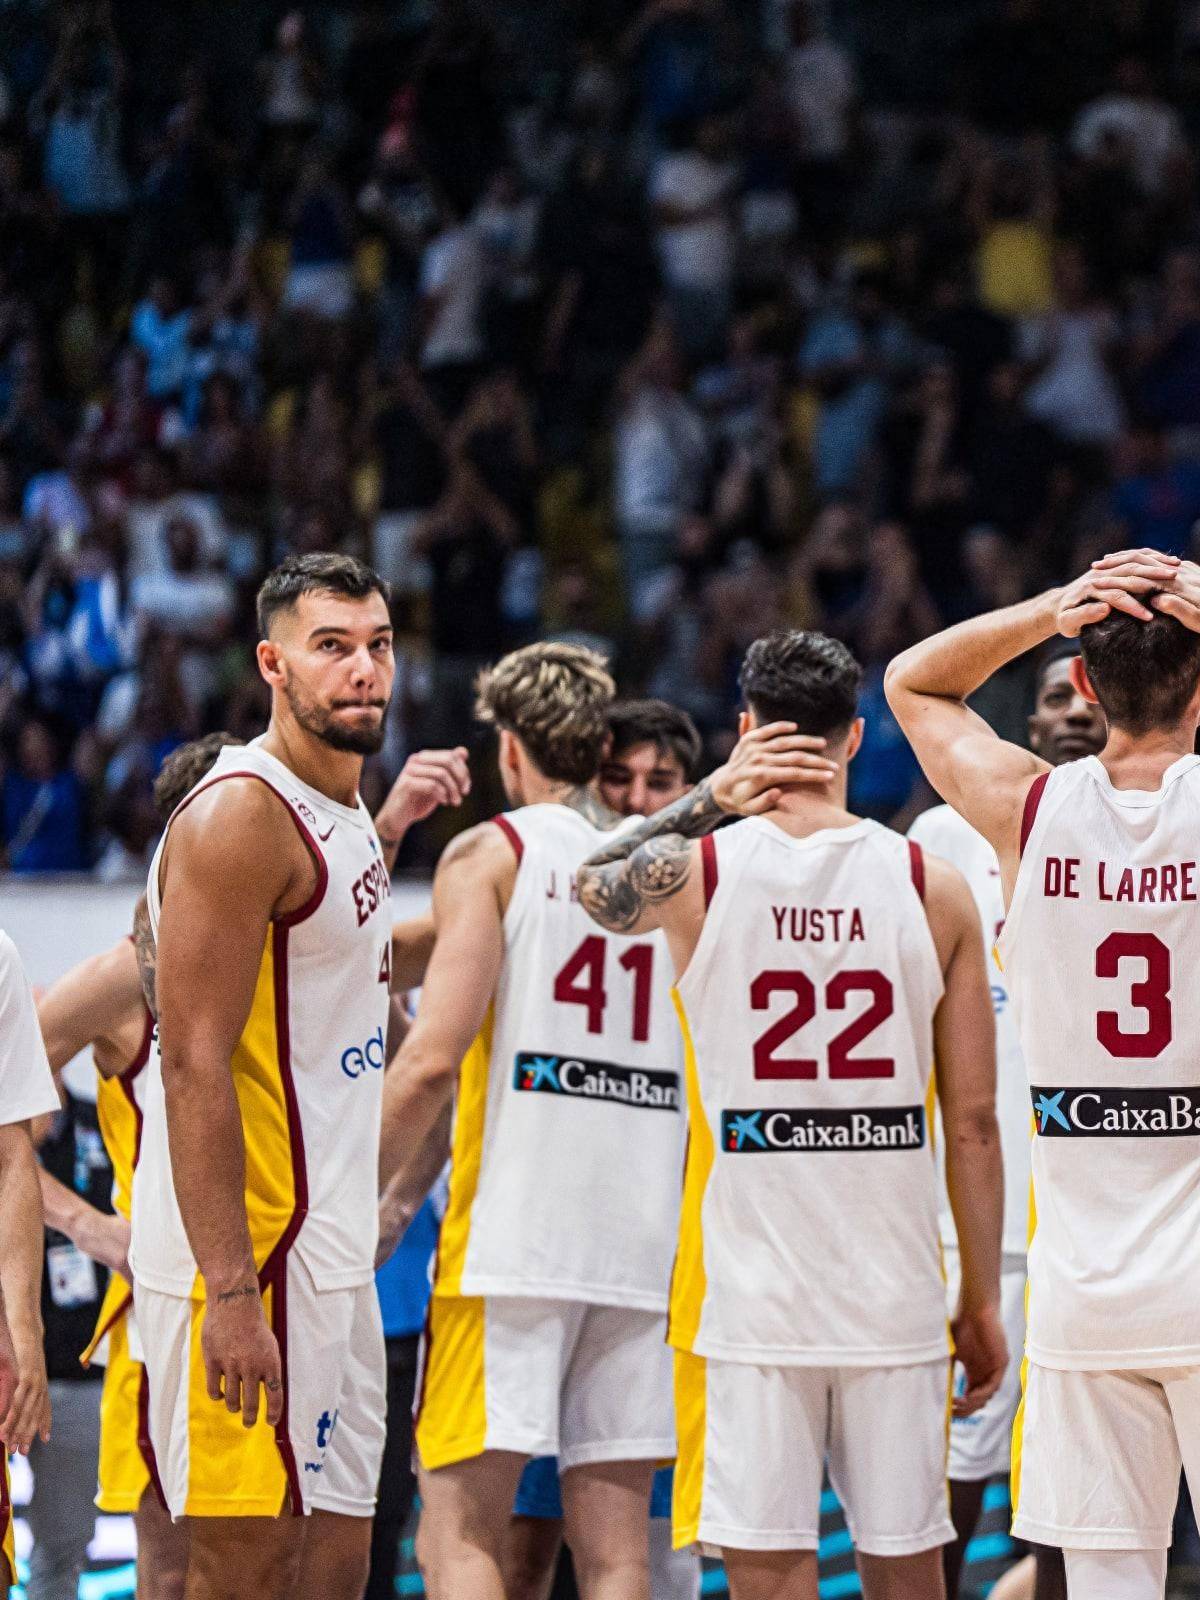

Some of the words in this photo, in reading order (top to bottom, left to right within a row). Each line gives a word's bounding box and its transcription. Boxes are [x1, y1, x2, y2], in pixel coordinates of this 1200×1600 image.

[1044, 857, 1080, 898] DE
[771, 906, 865, 942] YUSTA
[553, 933, 655, 1043] 41
[750, 969, 895, 1081] 22
[1095, 932, 1172, 1058] 3
[764, 1112, 921, 1148] CaixaBank
